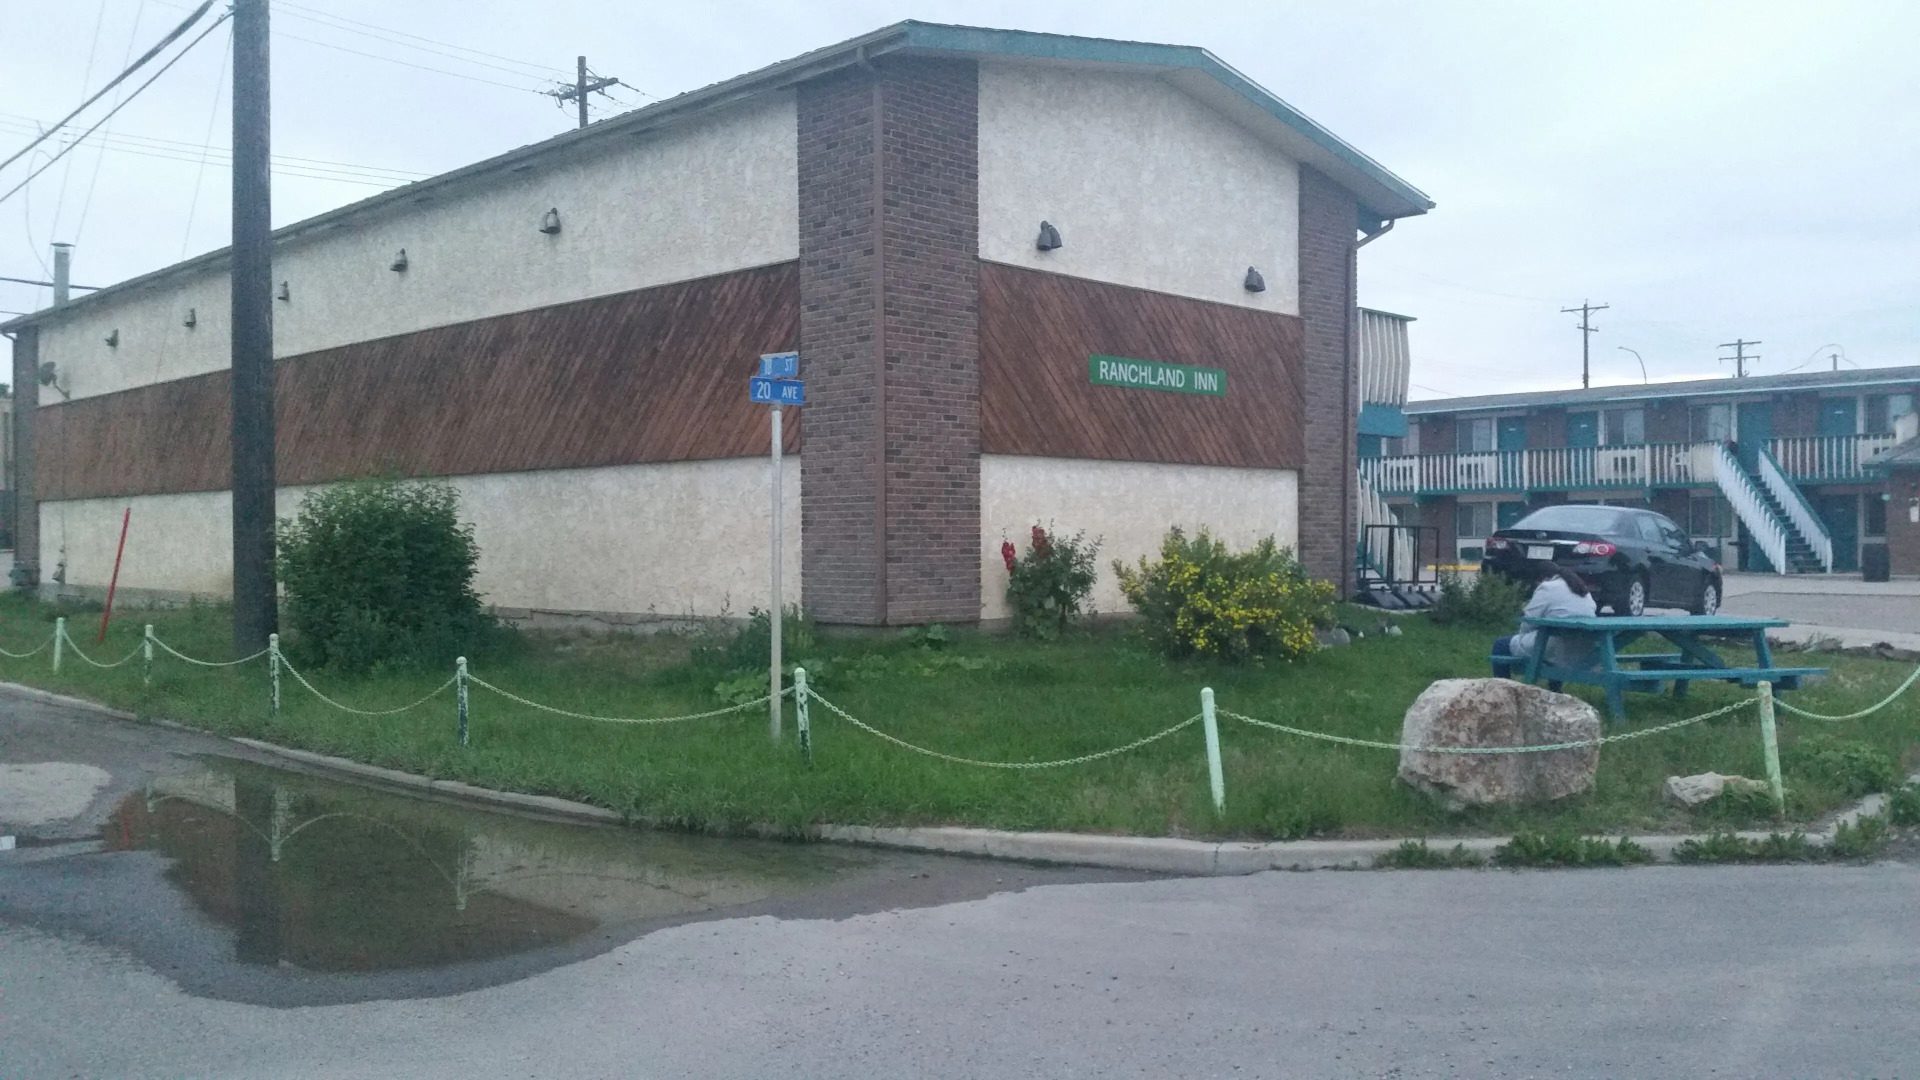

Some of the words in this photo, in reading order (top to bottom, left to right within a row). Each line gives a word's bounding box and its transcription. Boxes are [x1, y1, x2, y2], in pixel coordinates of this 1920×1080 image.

[784, 358, 794, 372] ST
[1099, 360, 1185, 388] RANCHLAND
[1194, 371, 1218, 392] INN
[757, 381, 771, 399] 20
[781, 386, 798, 400] AVE
